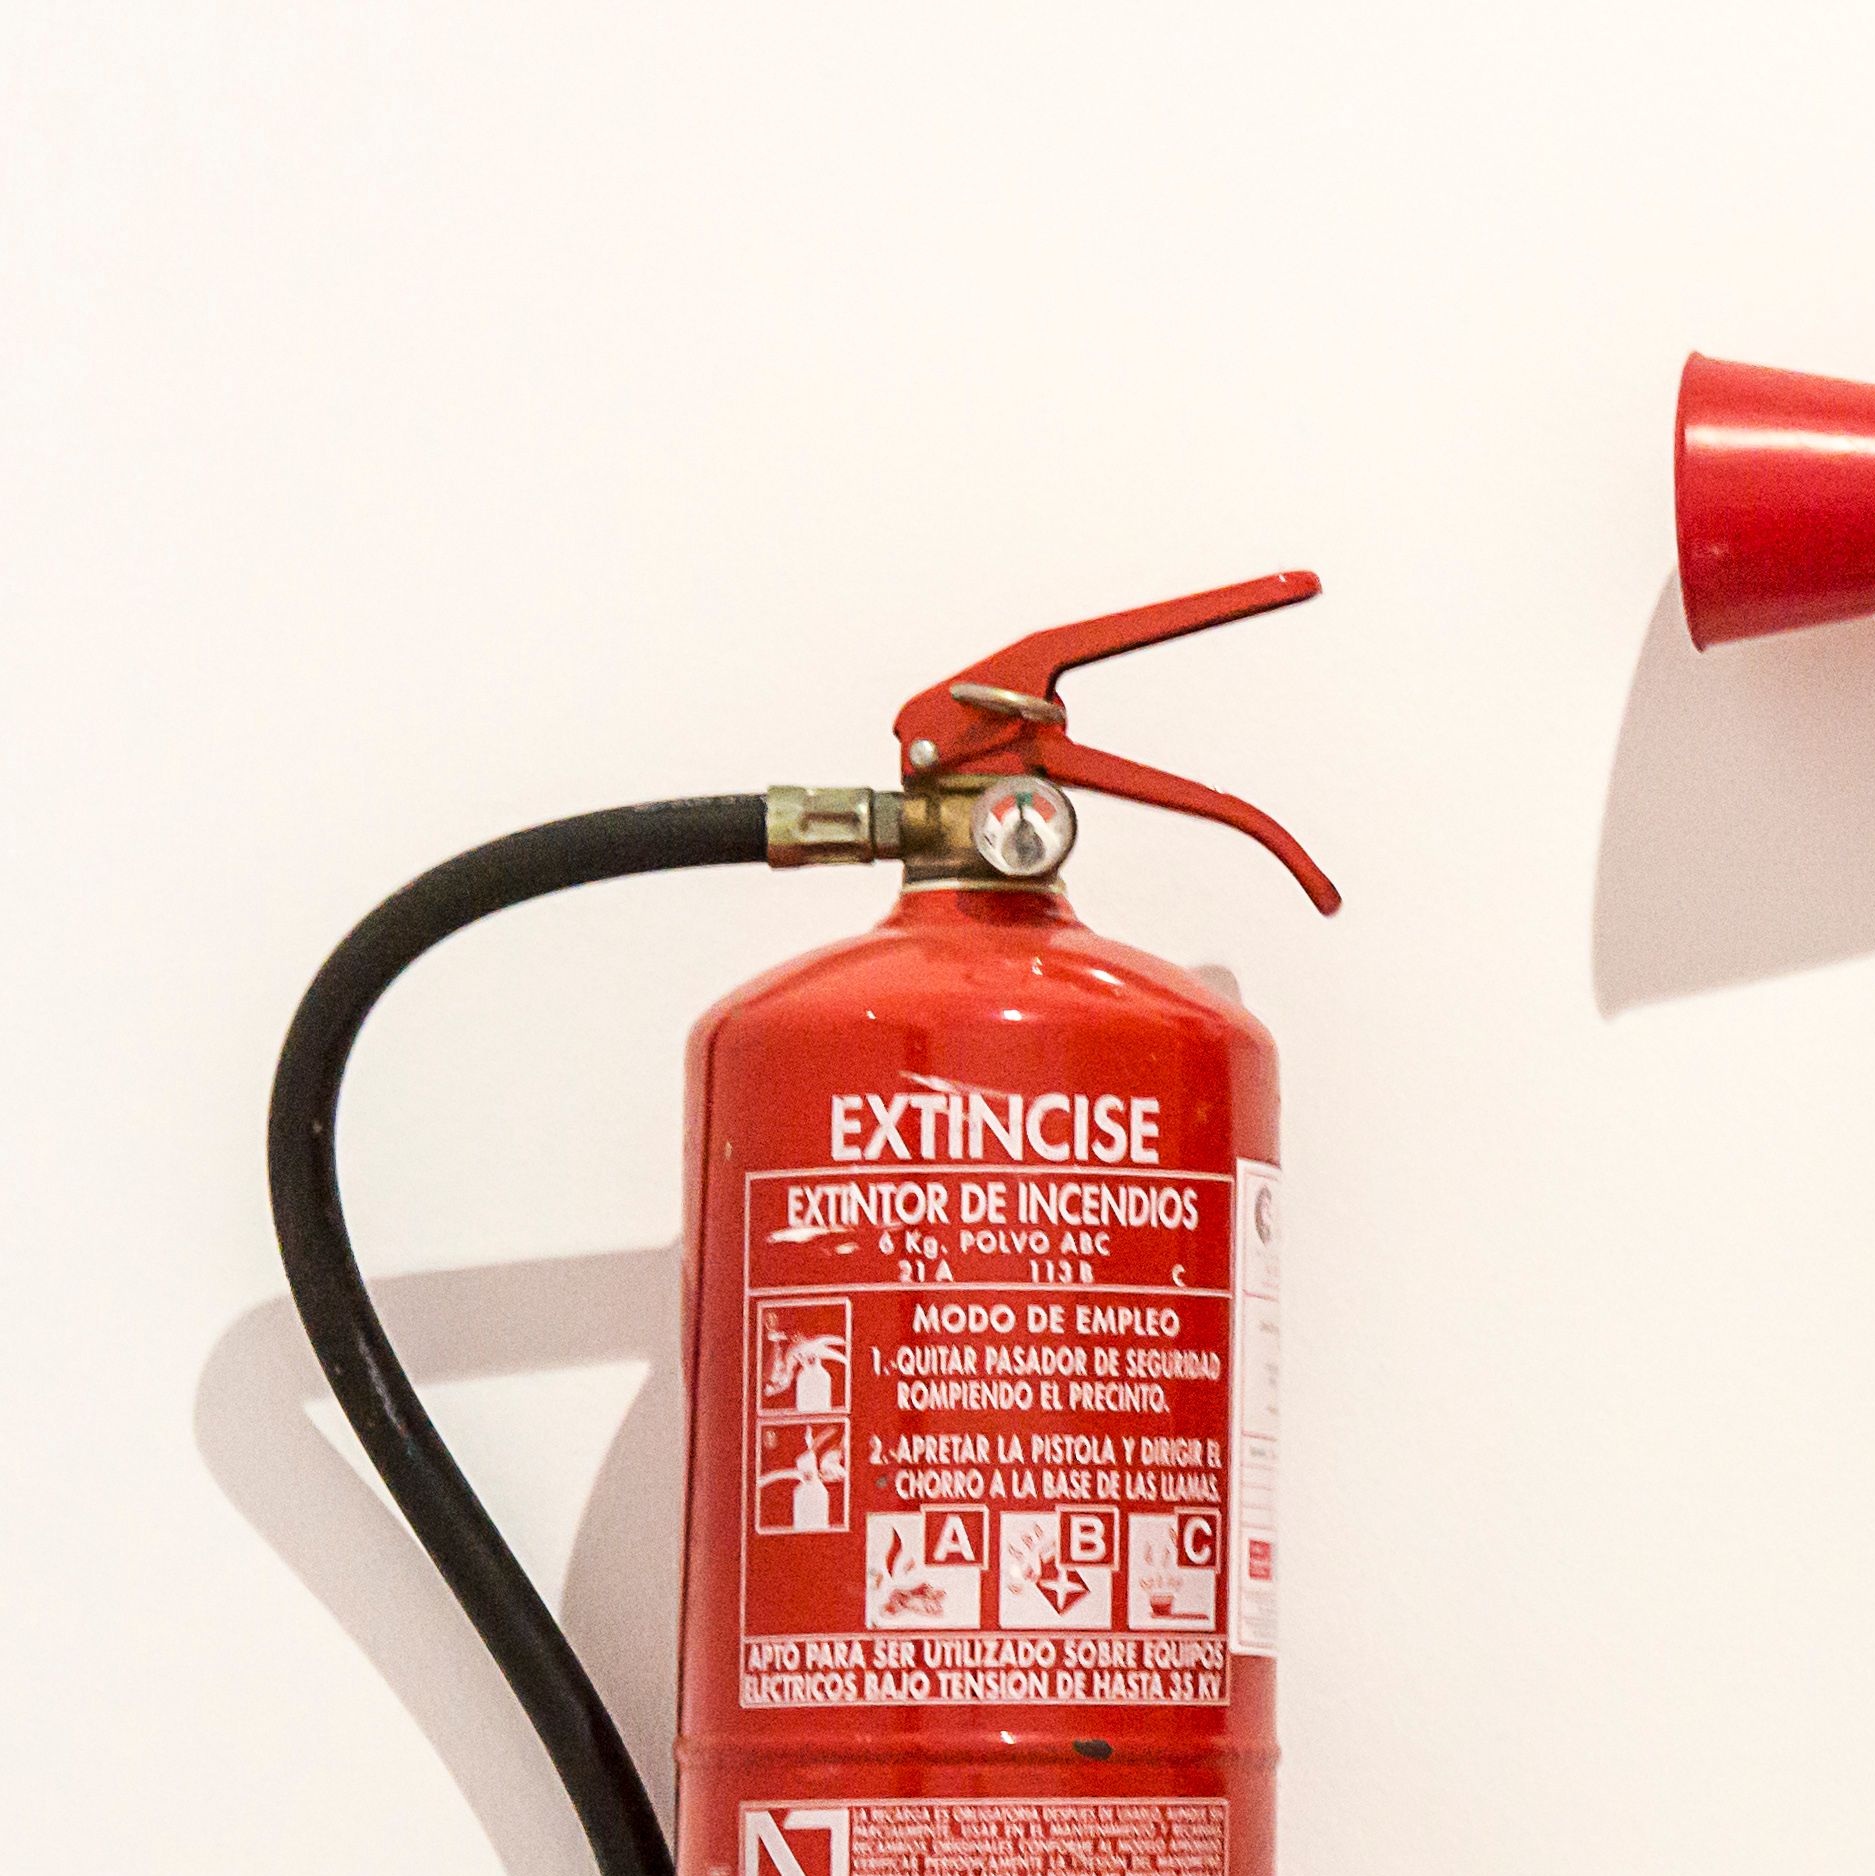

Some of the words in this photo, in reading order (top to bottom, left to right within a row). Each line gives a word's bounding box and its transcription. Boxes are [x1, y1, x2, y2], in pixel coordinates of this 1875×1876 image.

[830, 1094, 1160, 1164] EXTINCISE
[787, 1182, 950, 1227] EXTINTOR
[959, 1183, 1009, 1225] DE
[1017, 1186, 1200, 1231] INCENDIOS
[878, 1230, 894, 1255] 6
[905, 1231, 948, 1260] Kg.
[960, 1231, 1050, 1256] POLVO
[1060, 1232, 1111, 1257] ABC
[898, 1260, 926, 1284] 21
[935, 1260, 954, 1283] A
[1029, 1260, 1073, 1284] 113
[1078, 1260, 1095, 1284] B
[1171, 1264, 1188, 1288] C
[912, 1302, 1016, 1335] MODO
[1026, 1304, 1065, 1335] DE
[1076, 1306, 1181, 1338] EMPLEO
[985, 1347, 1087, 1378] PASADOR
[1094, 1349, 1120, 1378] DE
[1126, 1350, 1221, 1381] SEGURIDAD
[896, 1378, 1033, 1411] ROMPIENDO
[1040, 1380, 1062, 1411] EL
[1069, 1382, 1171, 1413] PRECINTO.
[997, 1436, 1024, 1466] LA
[1031, 1437, 1115, 1467] PISTOLA
[1121, 1438, 1136, 1467] Y
[1140, 1438, 1203, 1468] DIRIGIR
[895, 1468, 982, 1501] CHORRO
[989, 1470, 1006, 1500] A
[1012, 1470, 1038, 1500] LA
[1043, 1470, 1091, 1500] BASE
[1097, 1470, 1121, 1500] DE
[1125, 1471, 1157, 1501] LAS
[932, 1514, 976, 1562] A
[1070, 1517, 1108, 1562] B
[1182, 1519, 1213, 1564] C
[747, 1642, 802, 1672] APTO
[805, 1641, 865, 1670] PARA
[873, 1641, 916, 1670] SER
[923, 1641, 1056, 1670] UTILIZADO
[1063, 1642, 1139, 1670] SOBRE
[1143, 1642, 1225, 1670] EQUIPOS
[863, 1671, 931, 1702] BAJO
[937, 1671, 1049, 1702] TENSION
[1054, 1671, 1092, 1702] DE
[1097, 1671, 1165, 1702] HASTA
